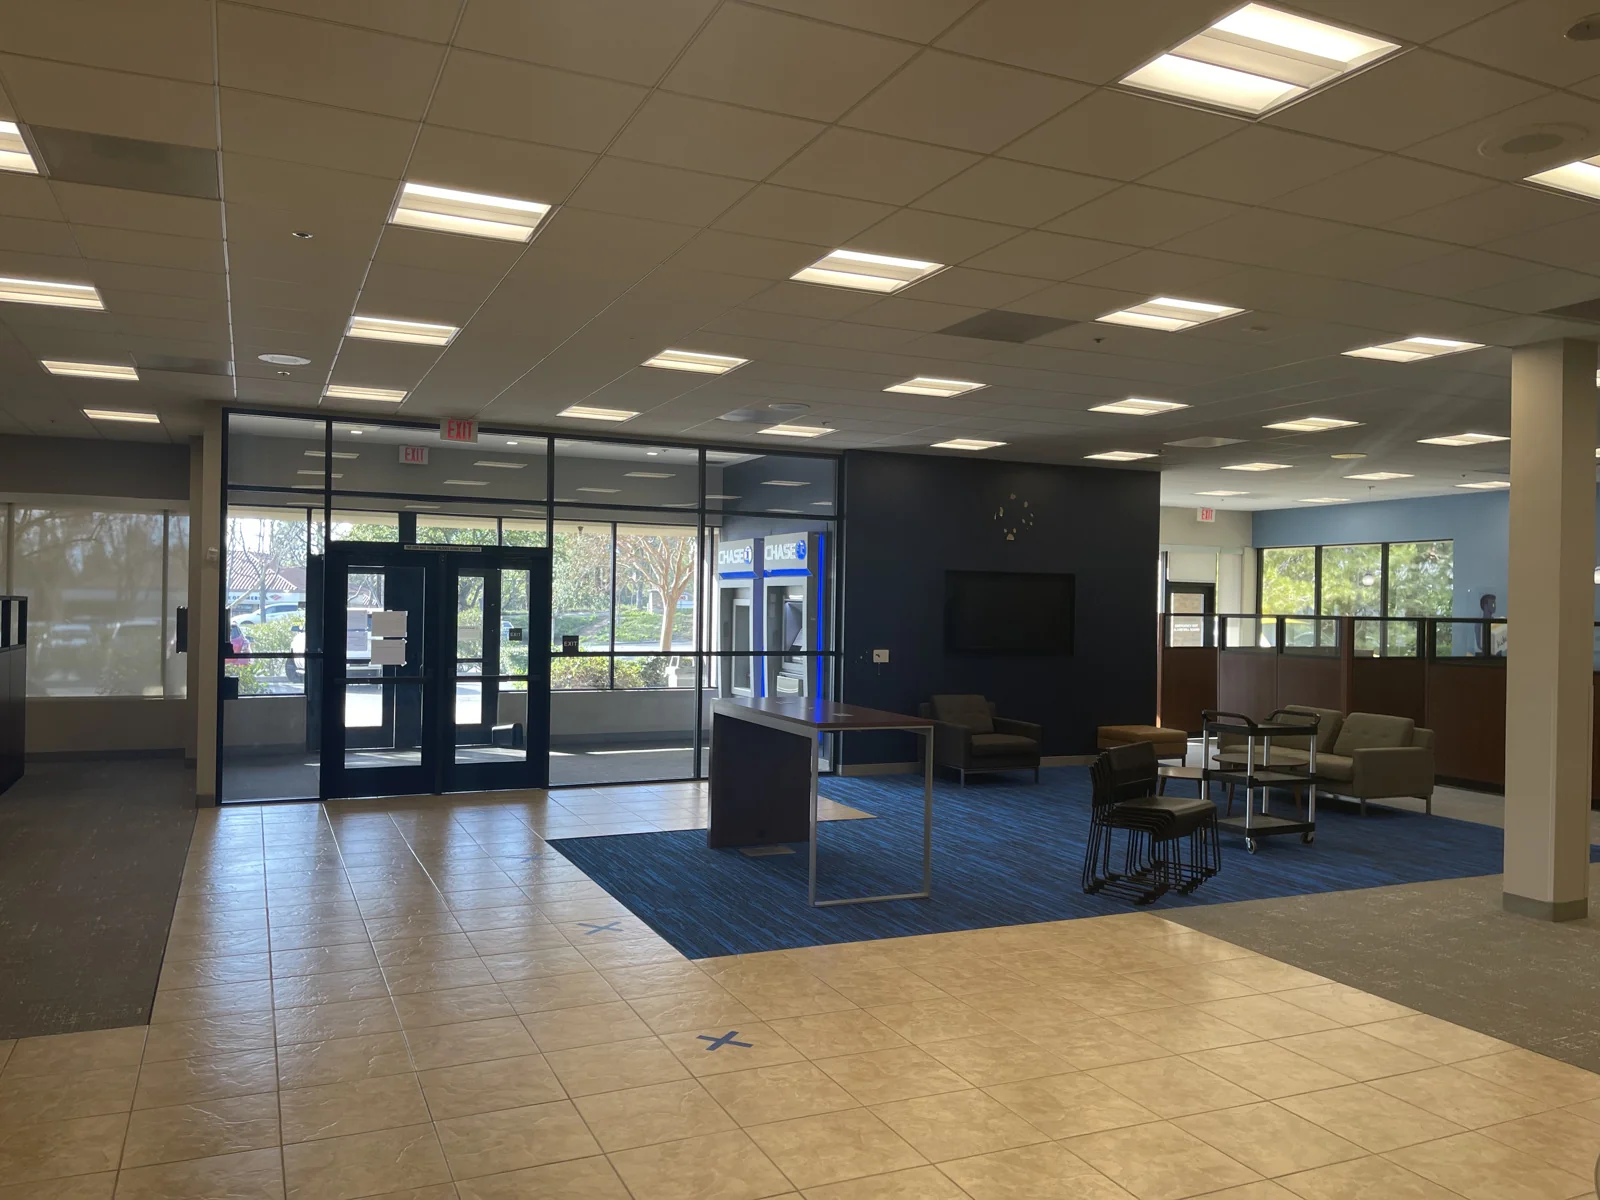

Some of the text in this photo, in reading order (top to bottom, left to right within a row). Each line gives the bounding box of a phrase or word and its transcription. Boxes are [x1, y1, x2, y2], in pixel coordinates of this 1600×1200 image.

[447, 419, 473, 440] EXIT
[404, 447, 424, 462] EXIT
[719, 549, 744, 564] CHASE
[765, 543, 797, 560] CHASE
